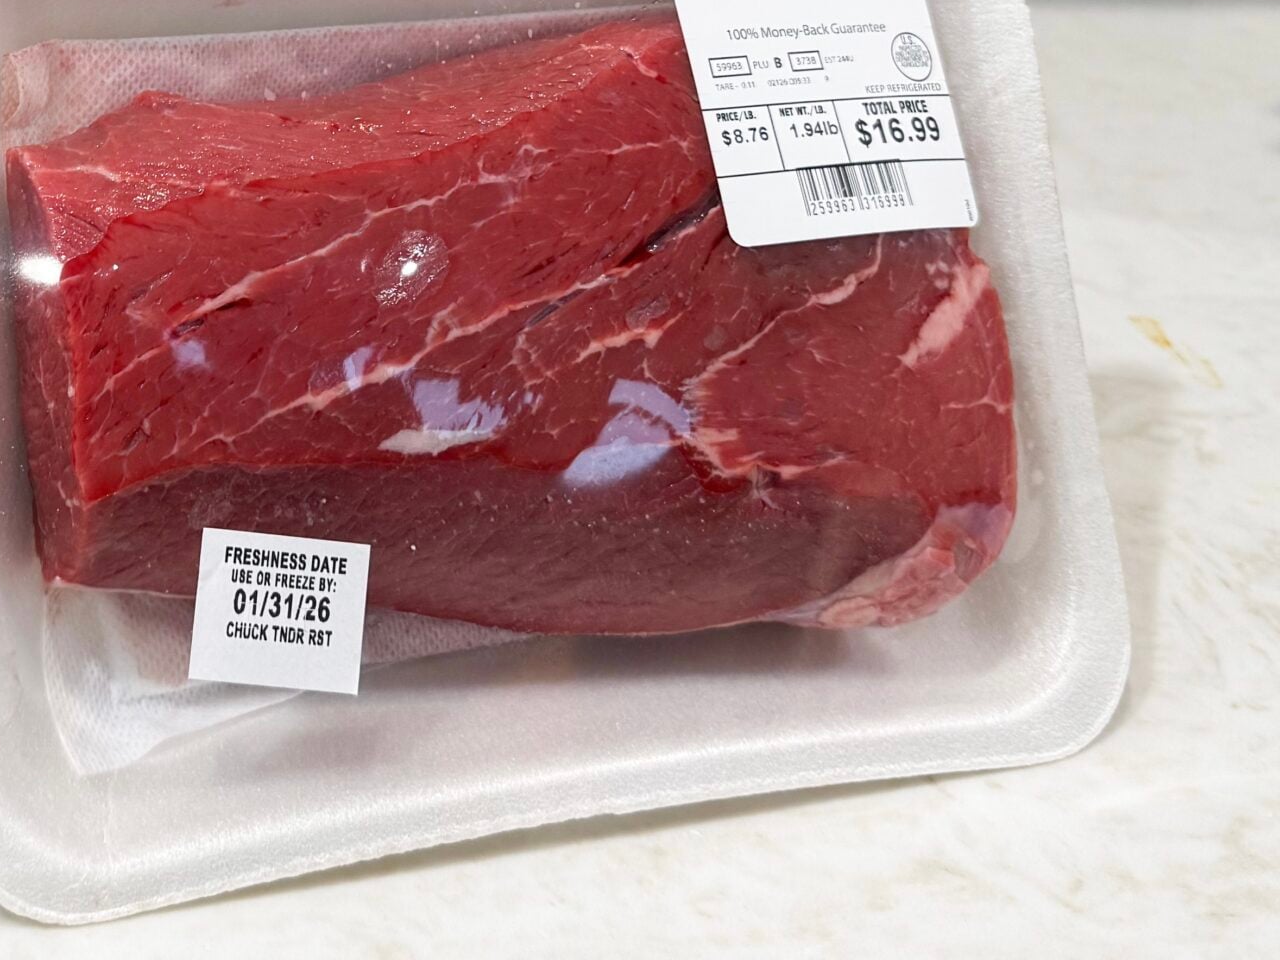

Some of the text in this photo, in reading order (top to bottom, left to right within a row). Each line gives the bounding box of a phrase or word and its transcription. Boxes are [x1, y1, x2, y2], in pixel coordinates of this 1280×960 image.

[727, 22, 887, 41] 100% Money-Back Guarantee
[715, 61, 743, 72] 59963
[753, 60, 769, 70] PLU
[773, 57, 782, 69] B
[865, 82, 942, 94] KEEP REFRIGERATED
[716, 110, 757, 123] PRICE/LB.
[779, 107, 795, 117] NET
[862, 99, 928, 117] TOTAL PRICE
[721, 125, 769, 146] $8.76
[789, 120, 839, 139] 1.94lb
[855, 116, 940, 148] $16.99
[225, 546, 347, 575] FRESHNESS DATE
[231, 568, 337, 593] USE OR FREEZE BY:
[233, 587, 331, 623] 01/31/26
[226, 621, 333, 648] CHUCK TNDR RST
